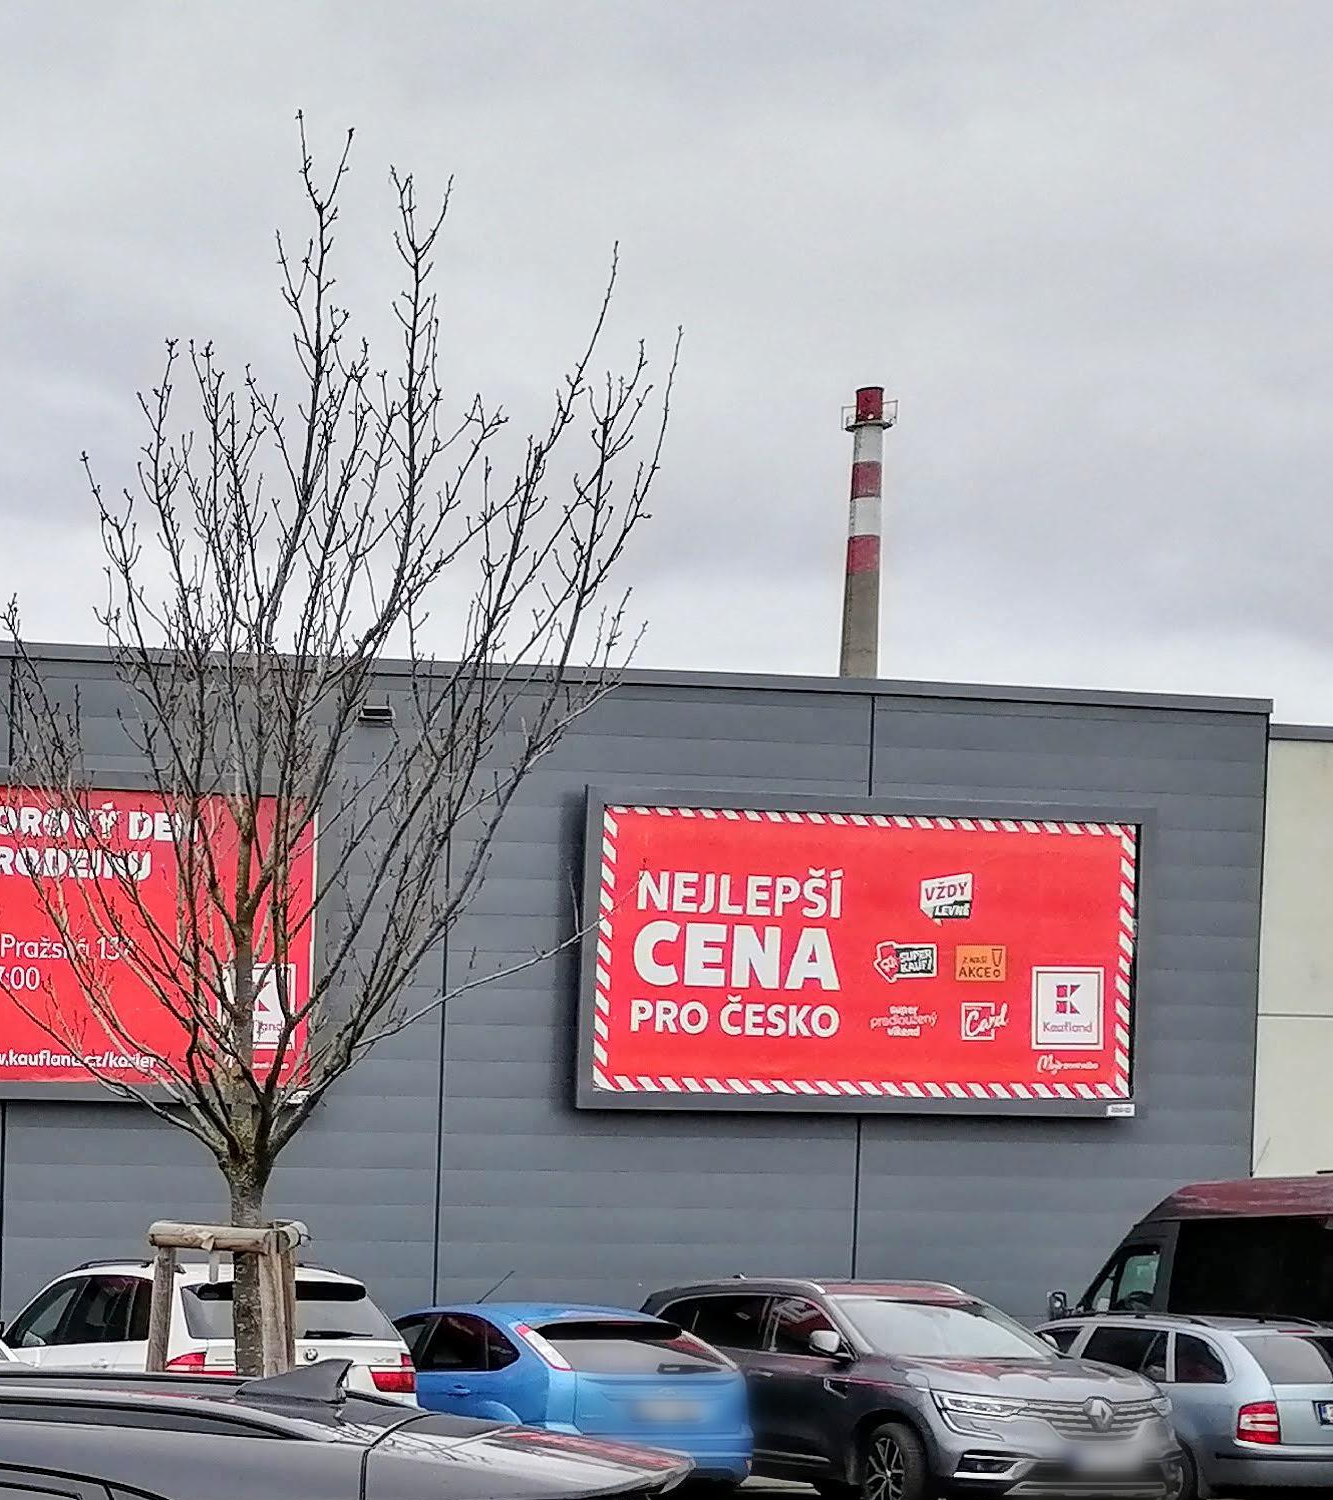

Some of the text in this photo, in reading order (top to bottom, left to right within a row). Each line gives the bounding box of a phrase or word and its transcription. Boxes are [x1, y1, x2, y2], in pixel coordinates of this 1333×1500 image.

[637, 867, 844, 919] NEJLEPŠÍ
[924, 881, 968, 901] VŽDY
[633, 919, 841, 990] CENA
[629, 994, 841, 1038] PRO ČESKO
[1042, 1021, 1093, 1033] Kaufland
